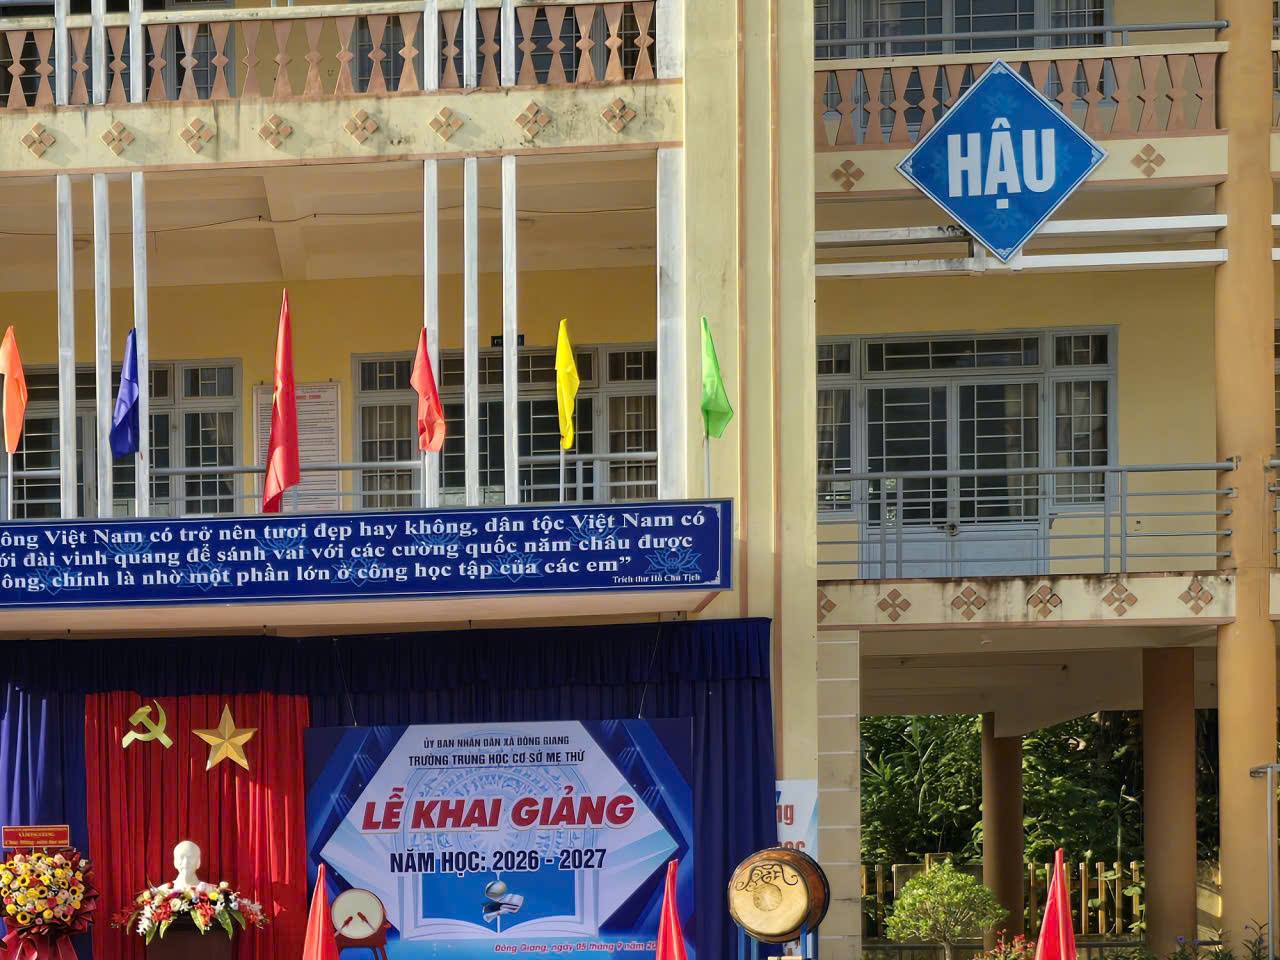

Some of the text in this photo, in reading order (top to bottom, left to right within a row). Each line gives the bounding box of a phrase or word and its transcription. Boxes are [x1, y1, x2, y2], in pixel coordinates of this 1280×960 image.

[947, 117, 1056, 210] HẬU
[45, 530, 87, 549] Việt
[94, 529, 143, 544] Nam
[150, 528, 173, 542] có
[180, 526, 213, 541] trở
[219, 525, 256, 540] nên
[264, 523, 307, 540] tươi
[313, 522, 352, 541] đẹp
[359, 521, 398, 540] hay
[405, 518, 478, 537] không,
[484, 516, 524, 533] dân
[532, 515, 565, 535] tộc
[571, 513, 616, 533] Việt
[622, 512, 673, 528] Nam
[681, 511, 705, 526] có
[23, 552, 55, 567] đài
[62, 550, 107, 566] vinh
[114, 551, 180, 568] quang
[186, 543, 211, 563] để
[217, 546, 266, 562] sánh
[273, 545, 304, 560] vai
[313, 543, 344, 559] với
[350, 543, 385, 558] các
[392, 543, 459, 559] cường
[465, 534, 517, 558] quốc
[524, 538, 570, 553] năm
[578, 535, 630, 551] châu
[637, 534, 693, 552] được
[52, 571, 110, 588] chính
[116, 570, 135, 586] là
[142, 570, 184, 585] nhờ
[189, 568, 231, 586] một
[236, 563, 289, 587] phần
[297, 566, 330, 580] lớn
[337, 563, 352, 579] ở
[357, 564, 408, 582] công
[415, 562, 452, 581] học
[459, 560, 493, 579] tập
[499, 559, 537, 574] của
[544, 556, 579, 574] các
[586, 556, 632, 572] em”
[682, 573, 700, 582] Tịch
[437, 739, 455, 748] BAN
[543, 735, 569, 745] GIANG
[409, 752, 449, 766] TRƯỜNG
[453, 754, 485, 765] TRUNG
[488, 753, 509, 767] HỌC
[512, 752, 526, 763] CƠ
[546, 752, 562, 766] MẸ
[361, 785, 636, 830] LỄ KHAI GIẢNG
[390, 849, 435, 873] NĂM
[441, 850, 487, 877] HỌC:
[492, 850, 539, 872] 2026
[559, 848, 607, 870] 2027
[646, 941, 657, 950] 20
